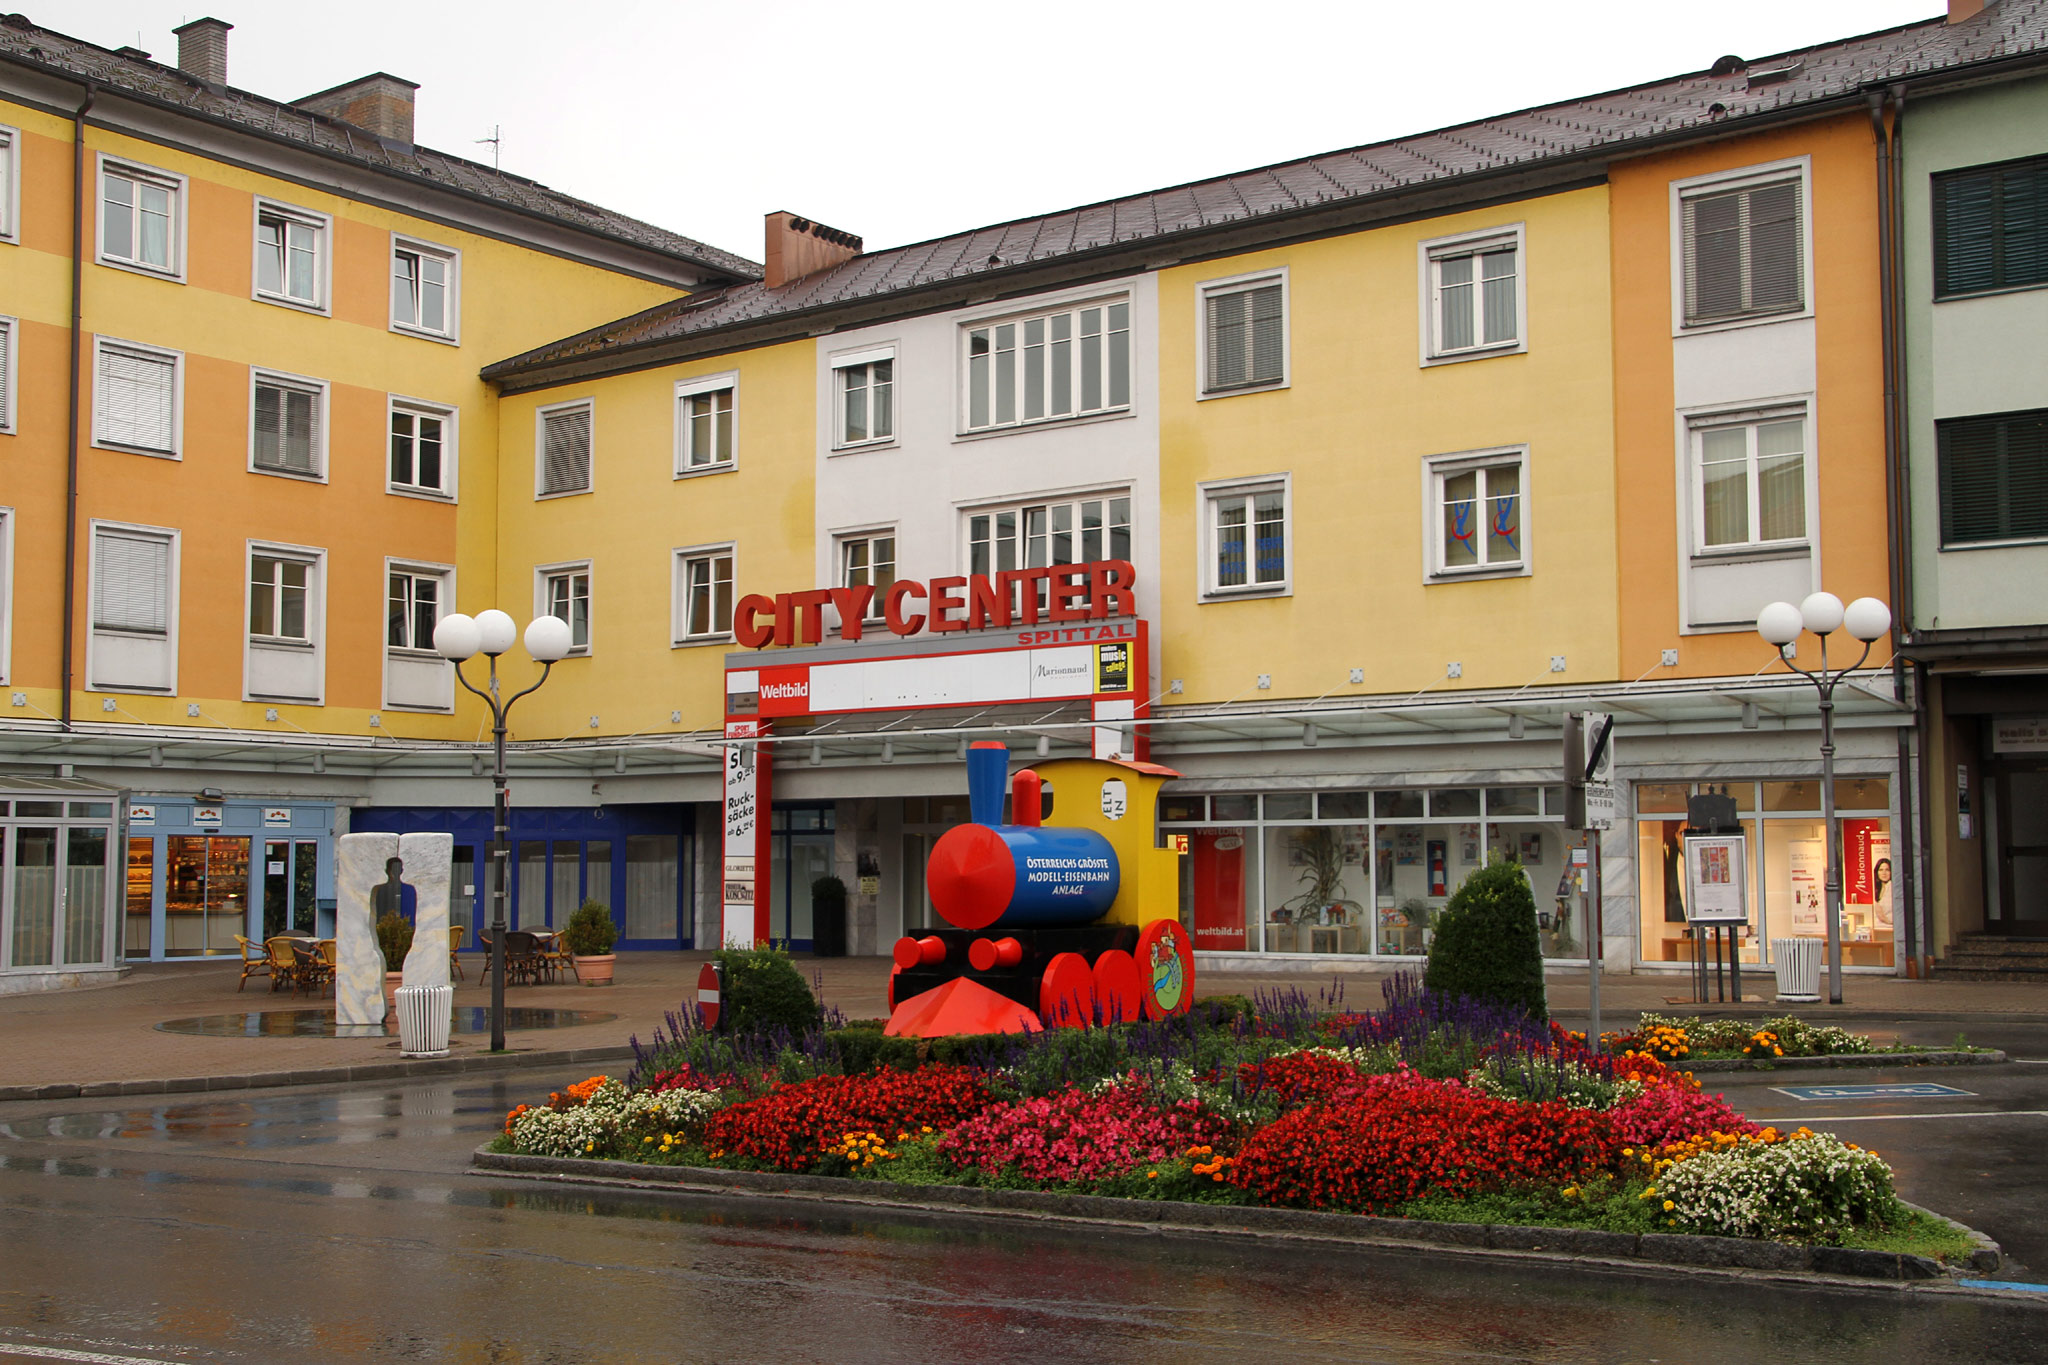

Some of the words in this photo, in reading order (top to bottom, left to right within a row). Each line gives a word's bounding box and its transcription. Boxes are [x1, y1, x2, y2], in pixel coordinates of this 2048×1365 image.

[734, 585, 876, 648] CITY
[884, 559, 1136, 636] CENTER
[1018, 624, 1132, 645] SPITTAL
[1101, 649, 1126, 662] music
[1032, 664, 1088, 680] Marionnaud
[760, 682, 808, 699] Weltbild
[728, 791, 754, 810] Ruck-
[728, 806, 754, 823] säcke
[1027, 856, 1077, 868] ÖSTERREICHS
[1078, 856, 1108, 868] GRÖSSTE
[1855, 834, 1869, 894] Marionnaud
[1028, 872, 1109, 882] MODELL-EISENBAHN
[1052, 885, 1084, 895] ANLAGE
[1197, 926, 1244, 936] weltbild.at
